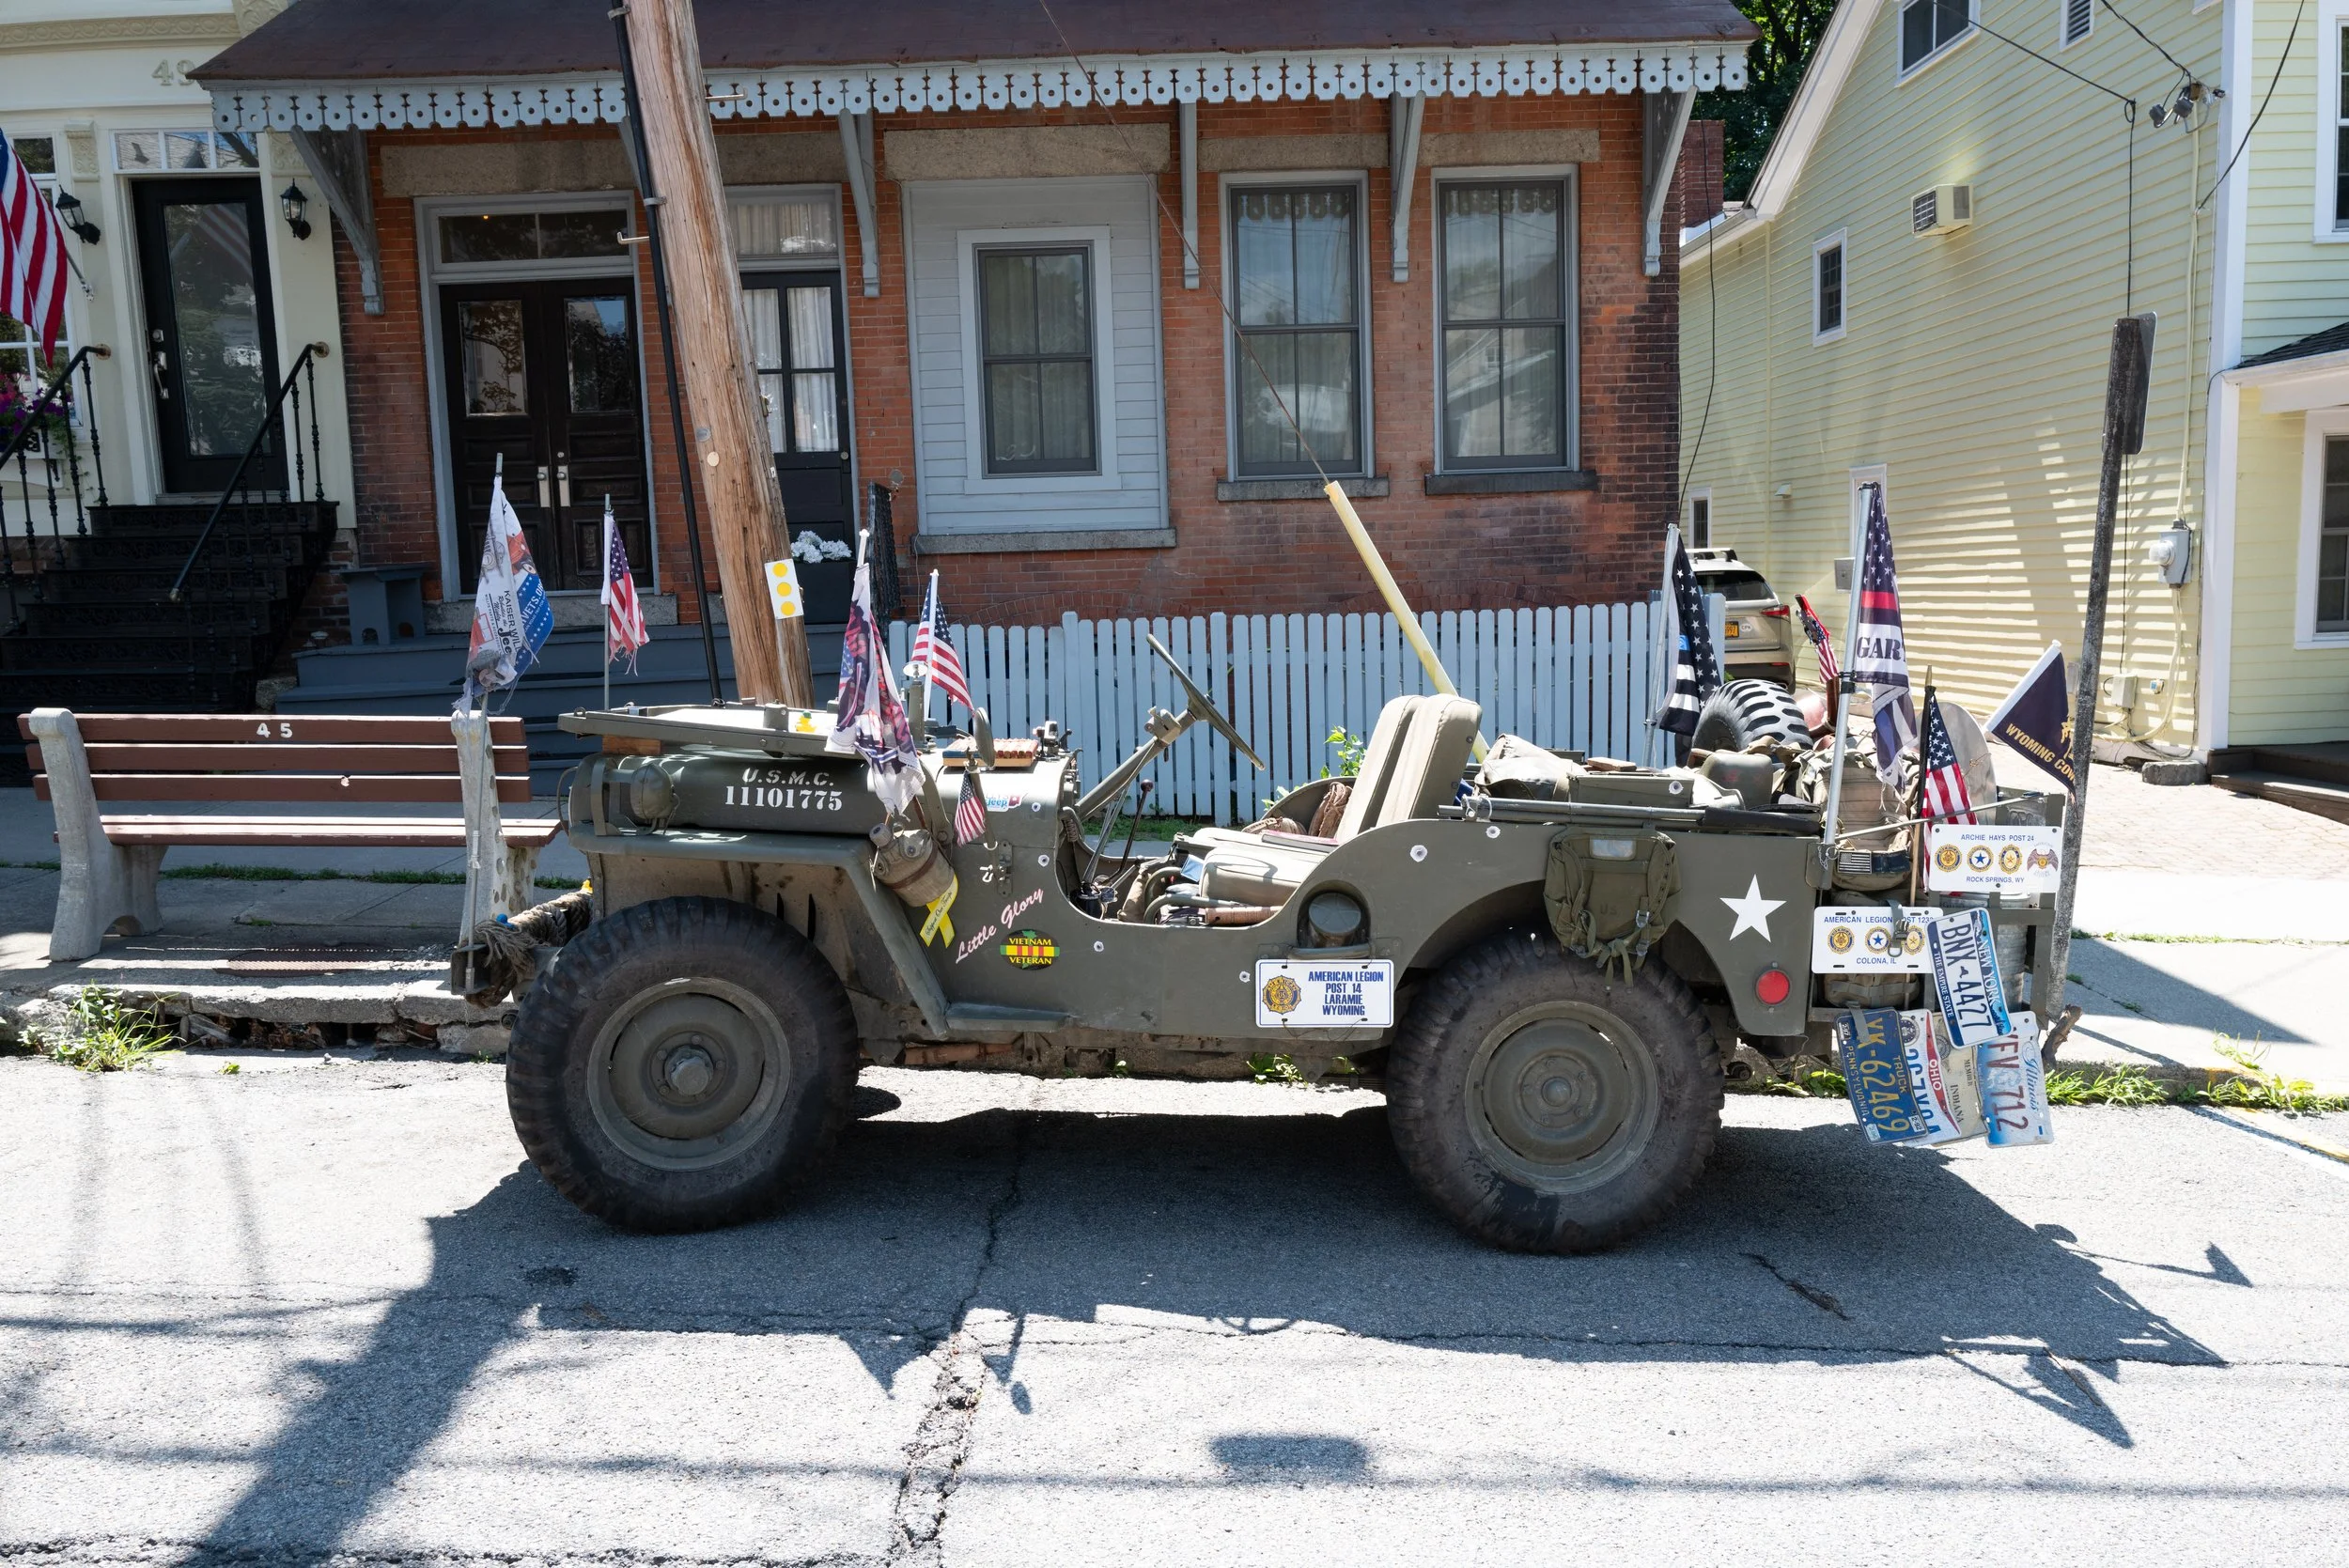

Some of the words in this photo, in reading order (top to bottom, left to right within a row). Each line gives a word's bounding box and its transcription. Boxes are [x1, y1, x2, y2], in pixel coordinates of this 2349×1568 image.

[504, 590, 515, 629] KAISER
[2005, 722, 2055, 763] WYOMING
[742, 767, 834, 786] U.S.M.C.
[724, 785, 843, 811] 11101775
[1985, 876, 2014, 884] SPRINGS,
[955, 924, 997, 964] Little
[1001, 888, 1044, 929] Glory
[1009, 938, 1052, 946] VIETNAM
[1941, 924, 1977, 967] BNX
[1976, 939, 1994, 968] NEW
[1009, 956, 1052, 965] VETERAN
[1934, 952, 1942, 968] THE
[1308, 970, 1353, 982] AMERICAN
[1355, 970, 1384, 982] LEGION
[1326, 983, 1346, 993] POST
[1351, 983, 1361, 993] 14
[1937, 968, 1949, 996] EMPIRE
[1983, 971, 2001, 1006] YORK
[1322, 1005, 1365, 1016] WYOMING
[1325, 994, 1362, 1004] LARAMIE
[1943, 996, 1954, 1017] STATE
[1952, 982, 1992, 1028] 4427
[1845, 1046, 1870, 1116] PENNSYLVANIA
[1893, 1054, 1907, 1094] TRUCK
[1929, 1059, 1942, 1091] OHIO
[1964, 1059, 1973, 1087] MEMBER
[2022, 1041, 2041, 1111] Illinois
[1950, 1084, 1964, 1124] INDIANA
[1991, 1085, 2030, 1132] 712
